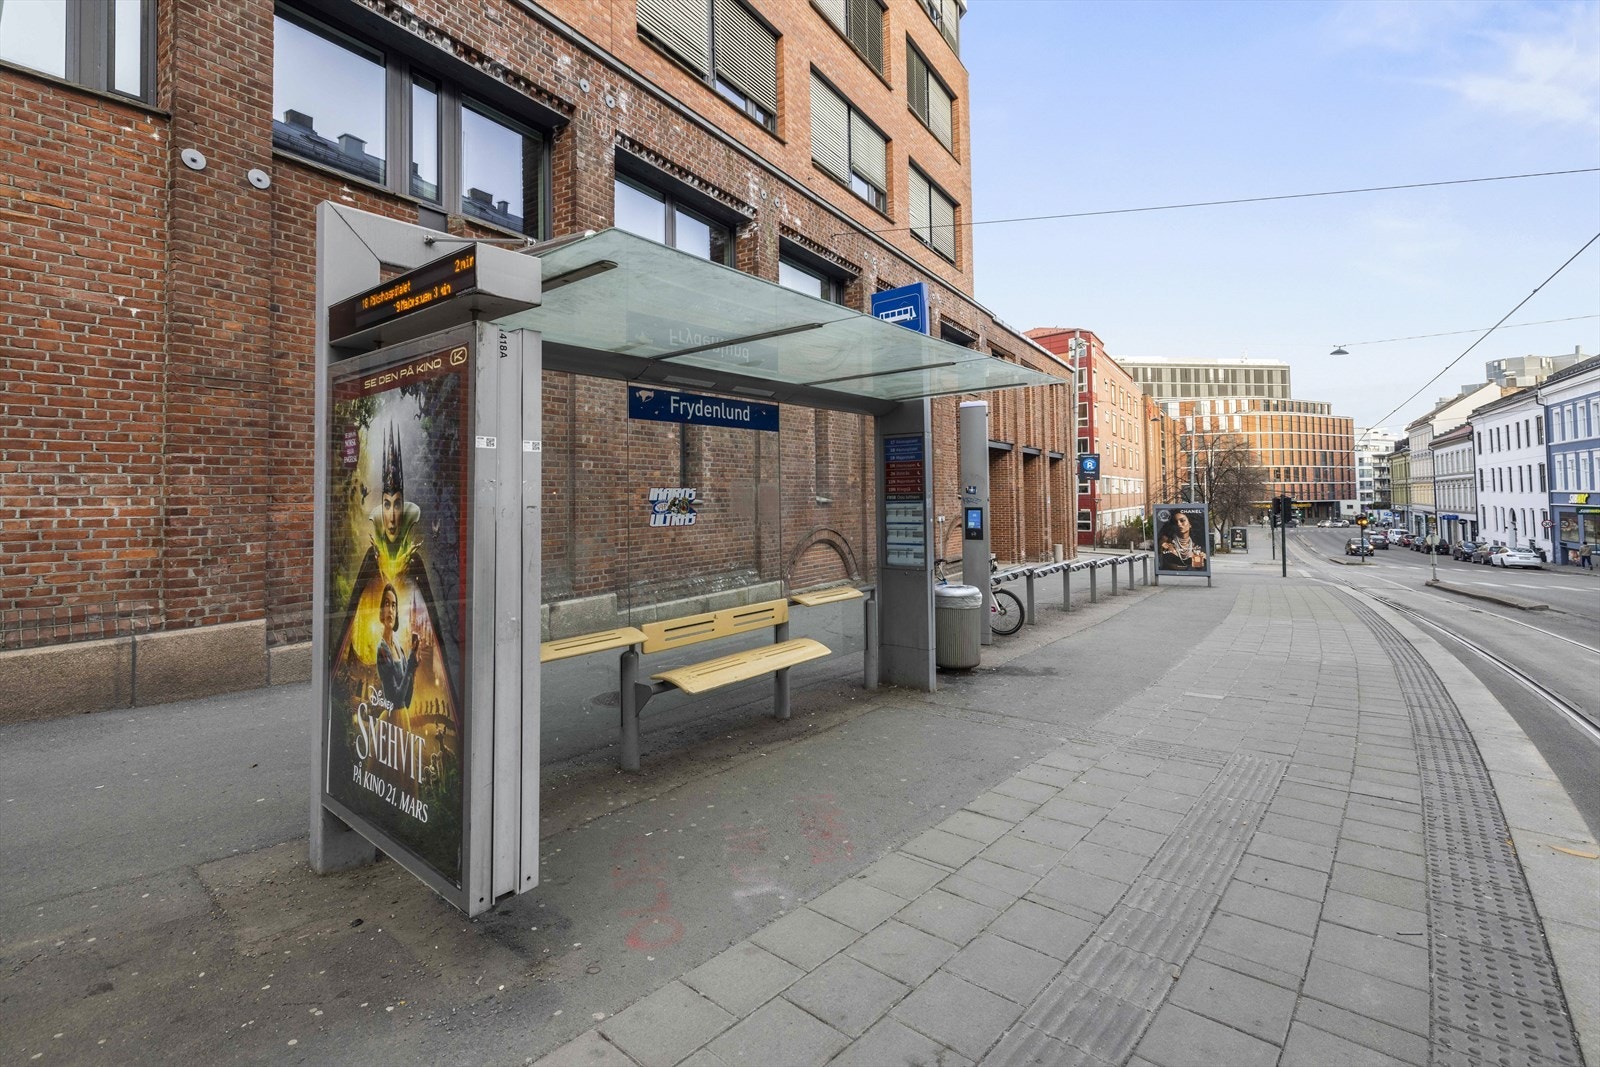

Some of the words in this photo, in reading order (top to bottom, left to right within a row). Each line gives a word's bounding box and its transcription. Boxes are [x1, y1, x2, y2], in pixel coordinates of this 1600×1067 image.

[362, 298, 369, 310] 18
[433, 286, 439, 298] 3
[499, 333, 508, 359] 418A
[364, 378, 377, 390] SE
[378, 371, 399, 385] DEN
[400, 365, 414, 379] PÅ
[416, 358, 442, 374] KINO
[670, 396, 750, 422] Frydenlund
[368, 685, 394, 717] Disney
[356, 702, 426, 784] SNEHVIT
[352, 761, 362, 785] PÅ
[363, 770, 386, 798] KINO
[385, 783, 397, 807] 21.
[399, 791, 429, 823] MARS
